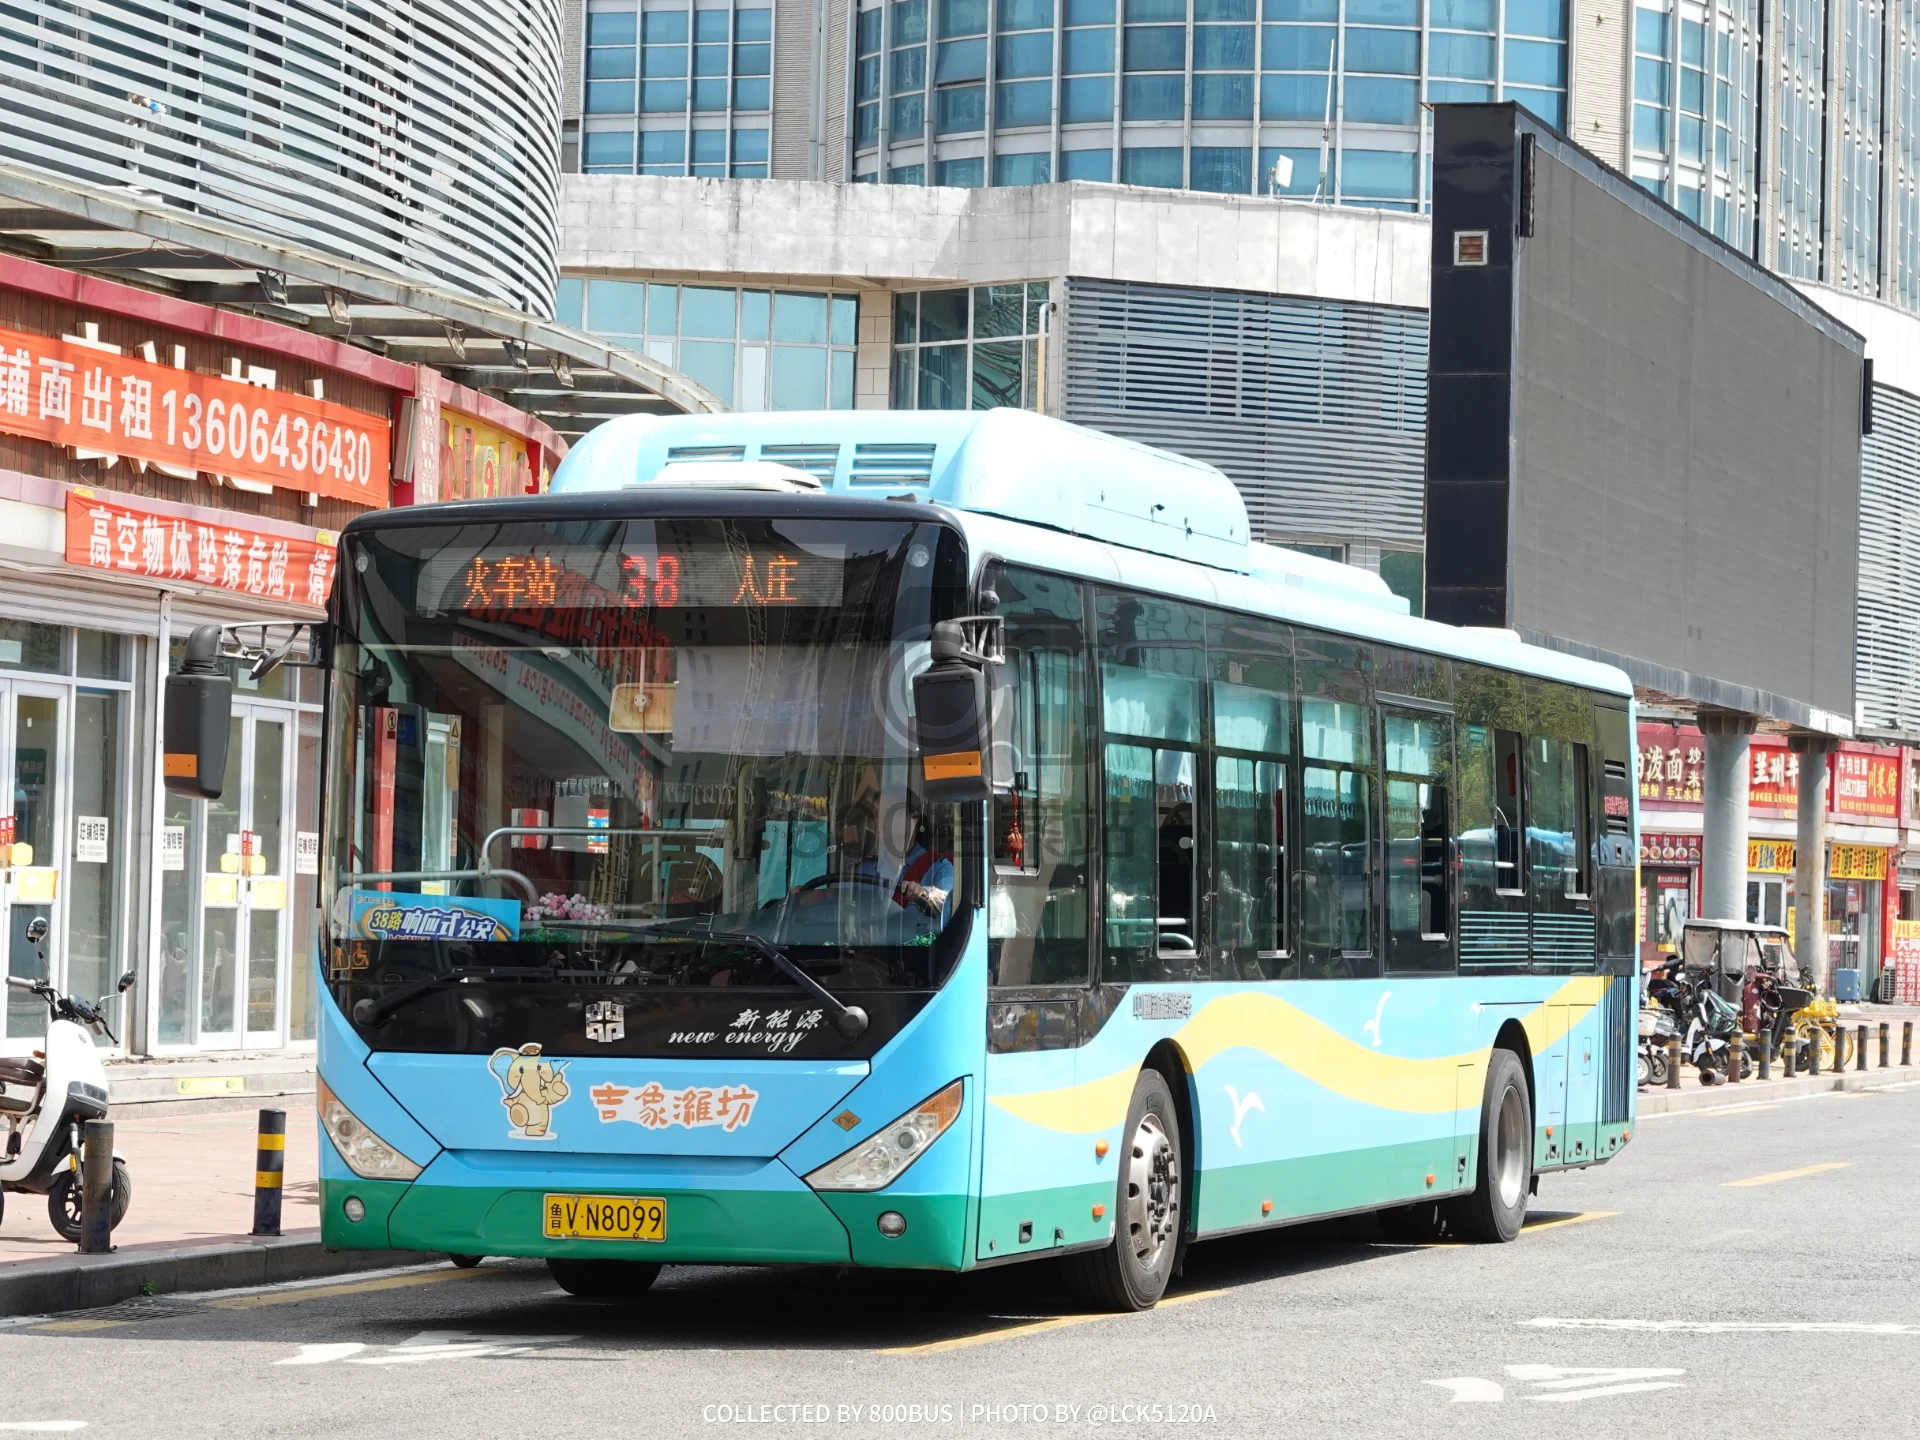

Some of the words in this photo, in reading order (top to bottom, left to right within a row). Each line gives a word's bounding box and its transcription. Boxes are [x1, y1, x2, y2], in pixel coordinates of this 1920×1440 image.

[89, 506, 336, 606] 高空物体坠落危险，请
[464, 556, 558, 608] 火车站
[623, 556, 679, 607] 38
[1687, 747, 1705, 764] 炒
[1839, 755, 1868, 776] 牛肉拉面
[1868, 762, 1898, 799] 川菜馆
[729, 1008, 824, 1030] 新能源
[668, 1031, 719, 1044] new
[725, 1031, 808, 1054] energy
[837, 1114, 856, 1126] CNG
